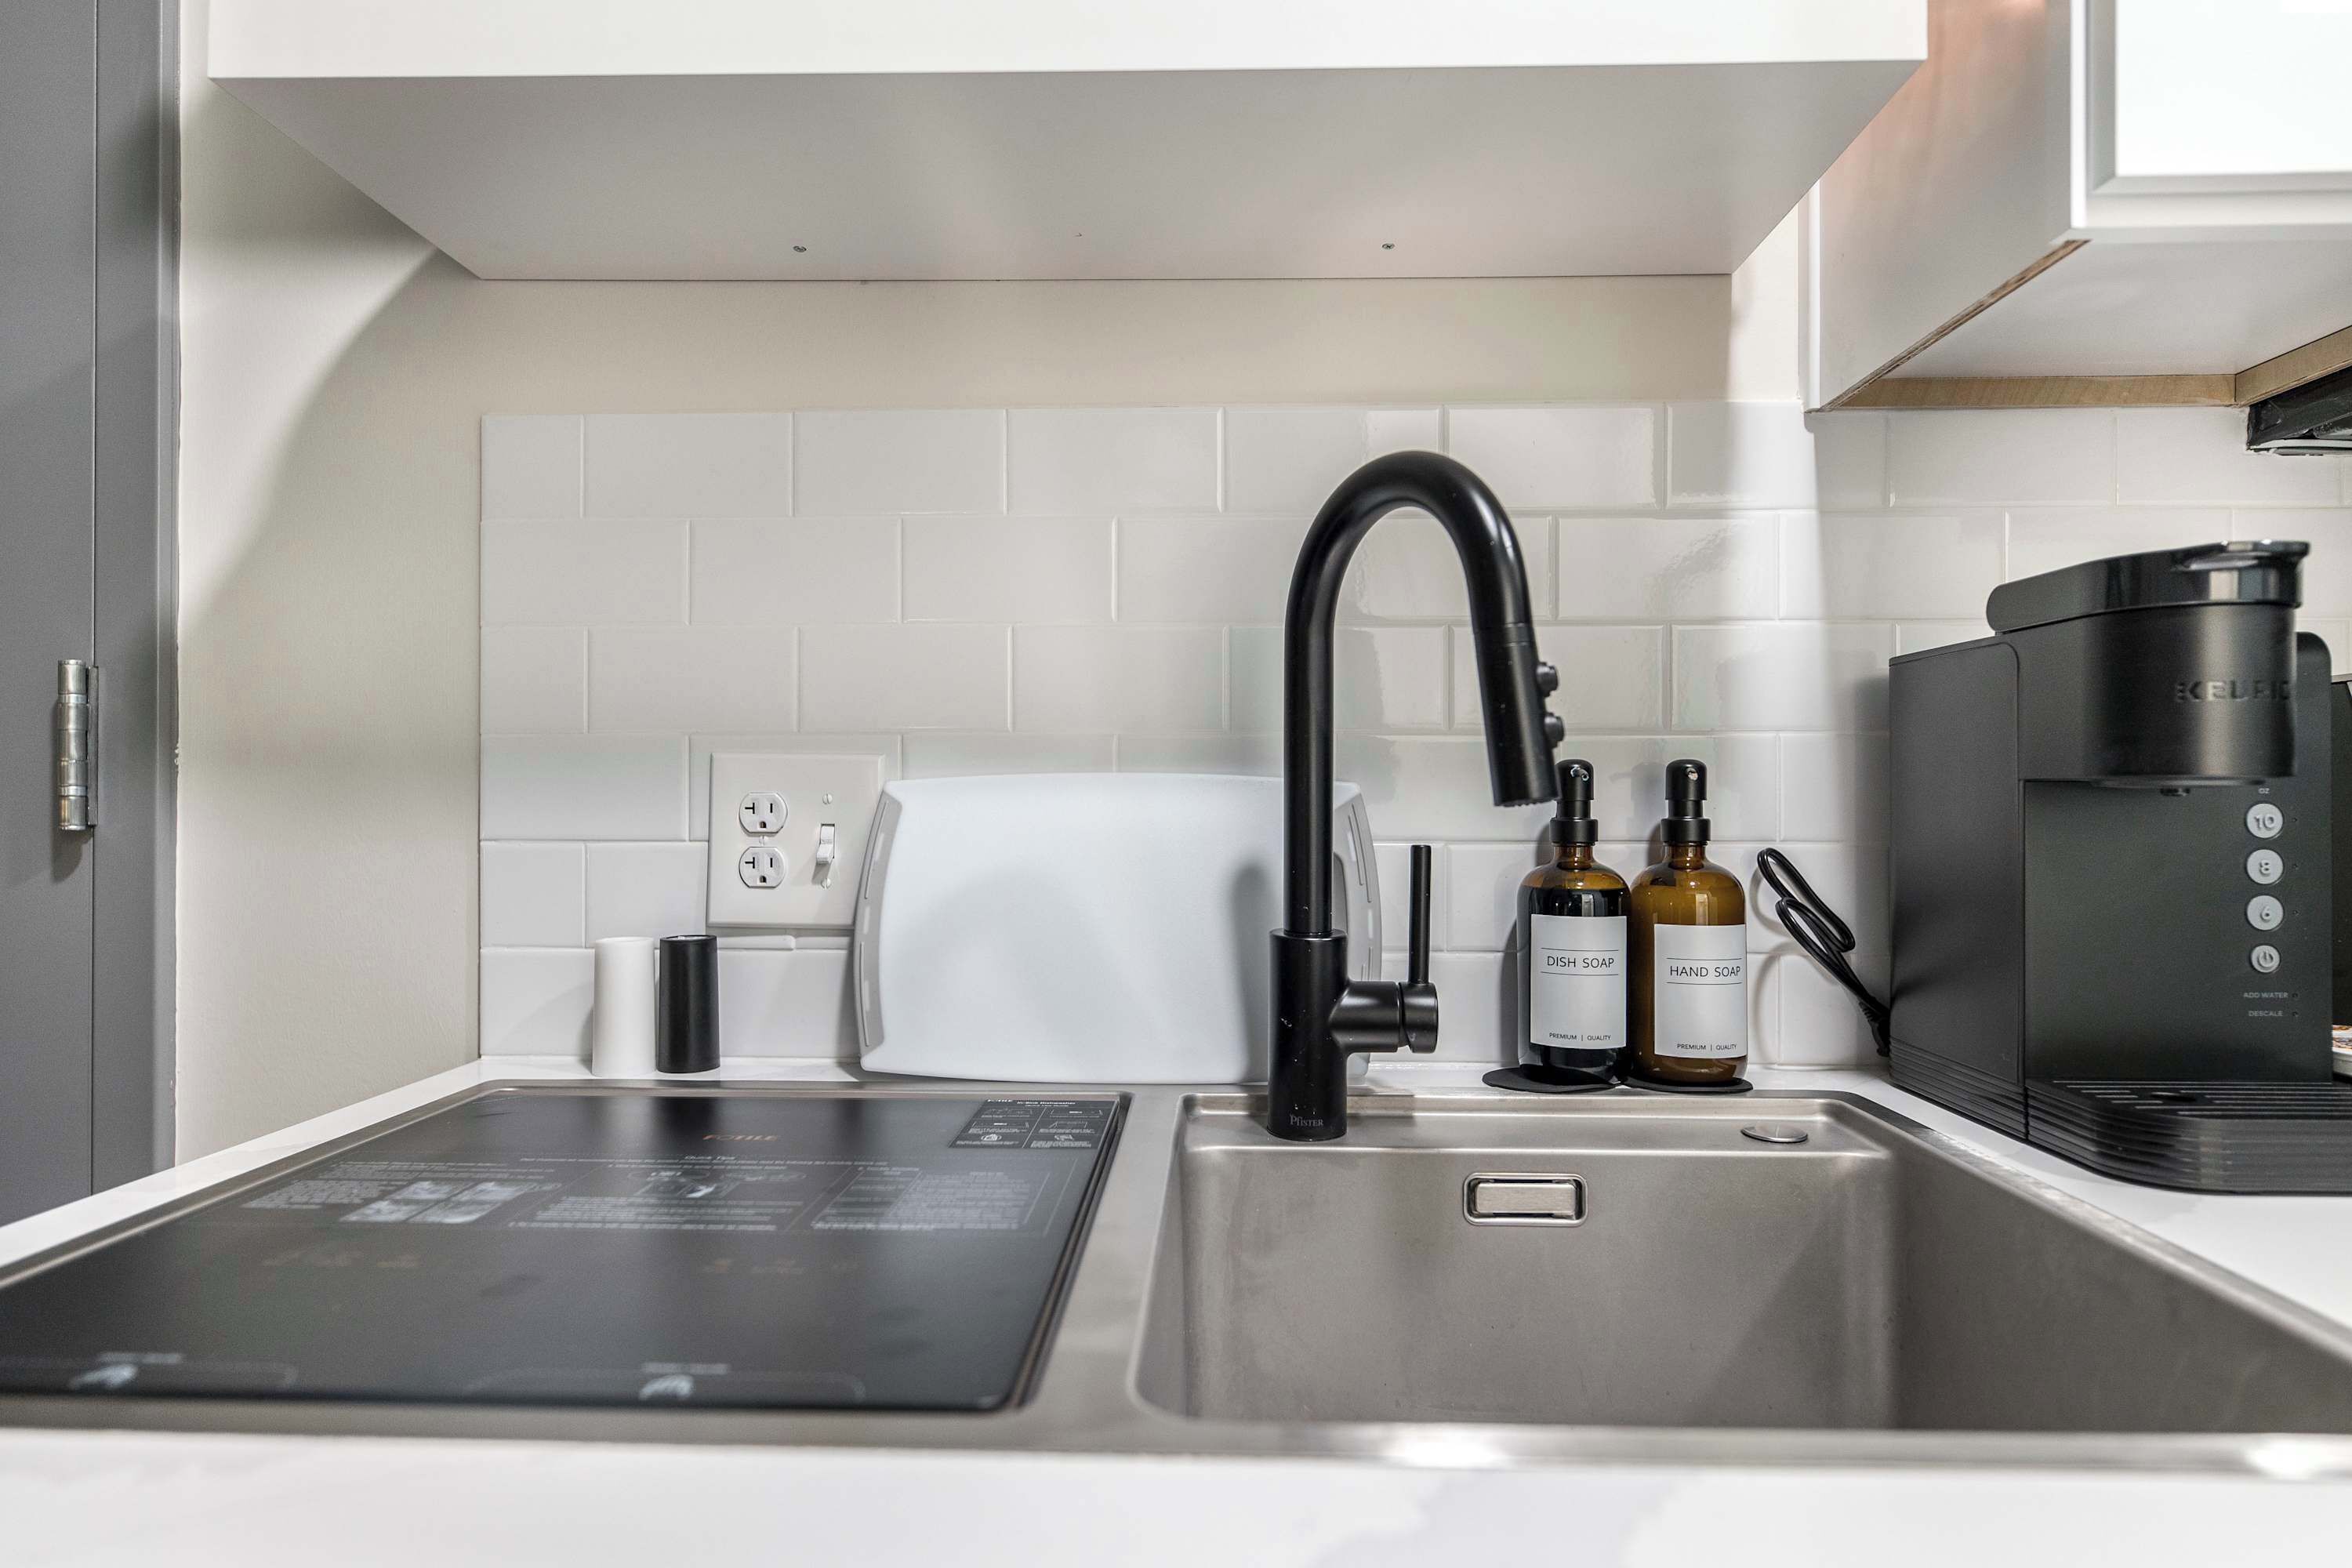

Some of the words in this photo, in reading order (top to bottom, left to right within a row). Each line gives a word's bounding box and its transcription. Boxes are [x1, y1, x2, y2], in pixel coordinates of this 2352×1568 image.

[2253, 814, 2275, 831] 10
[2259, 859, 2271, 877] 8
[2259, 905, 2272, 923] 6
[1547, 956, 1576, 967] DISH
[1582, 957, 1614, 968] SOAP
[1670, 965, 1708, 977] HAND
[1715, 966, 1740, 977] SOAP
[1548, 1032, 1577, 1040] PREMIUM
